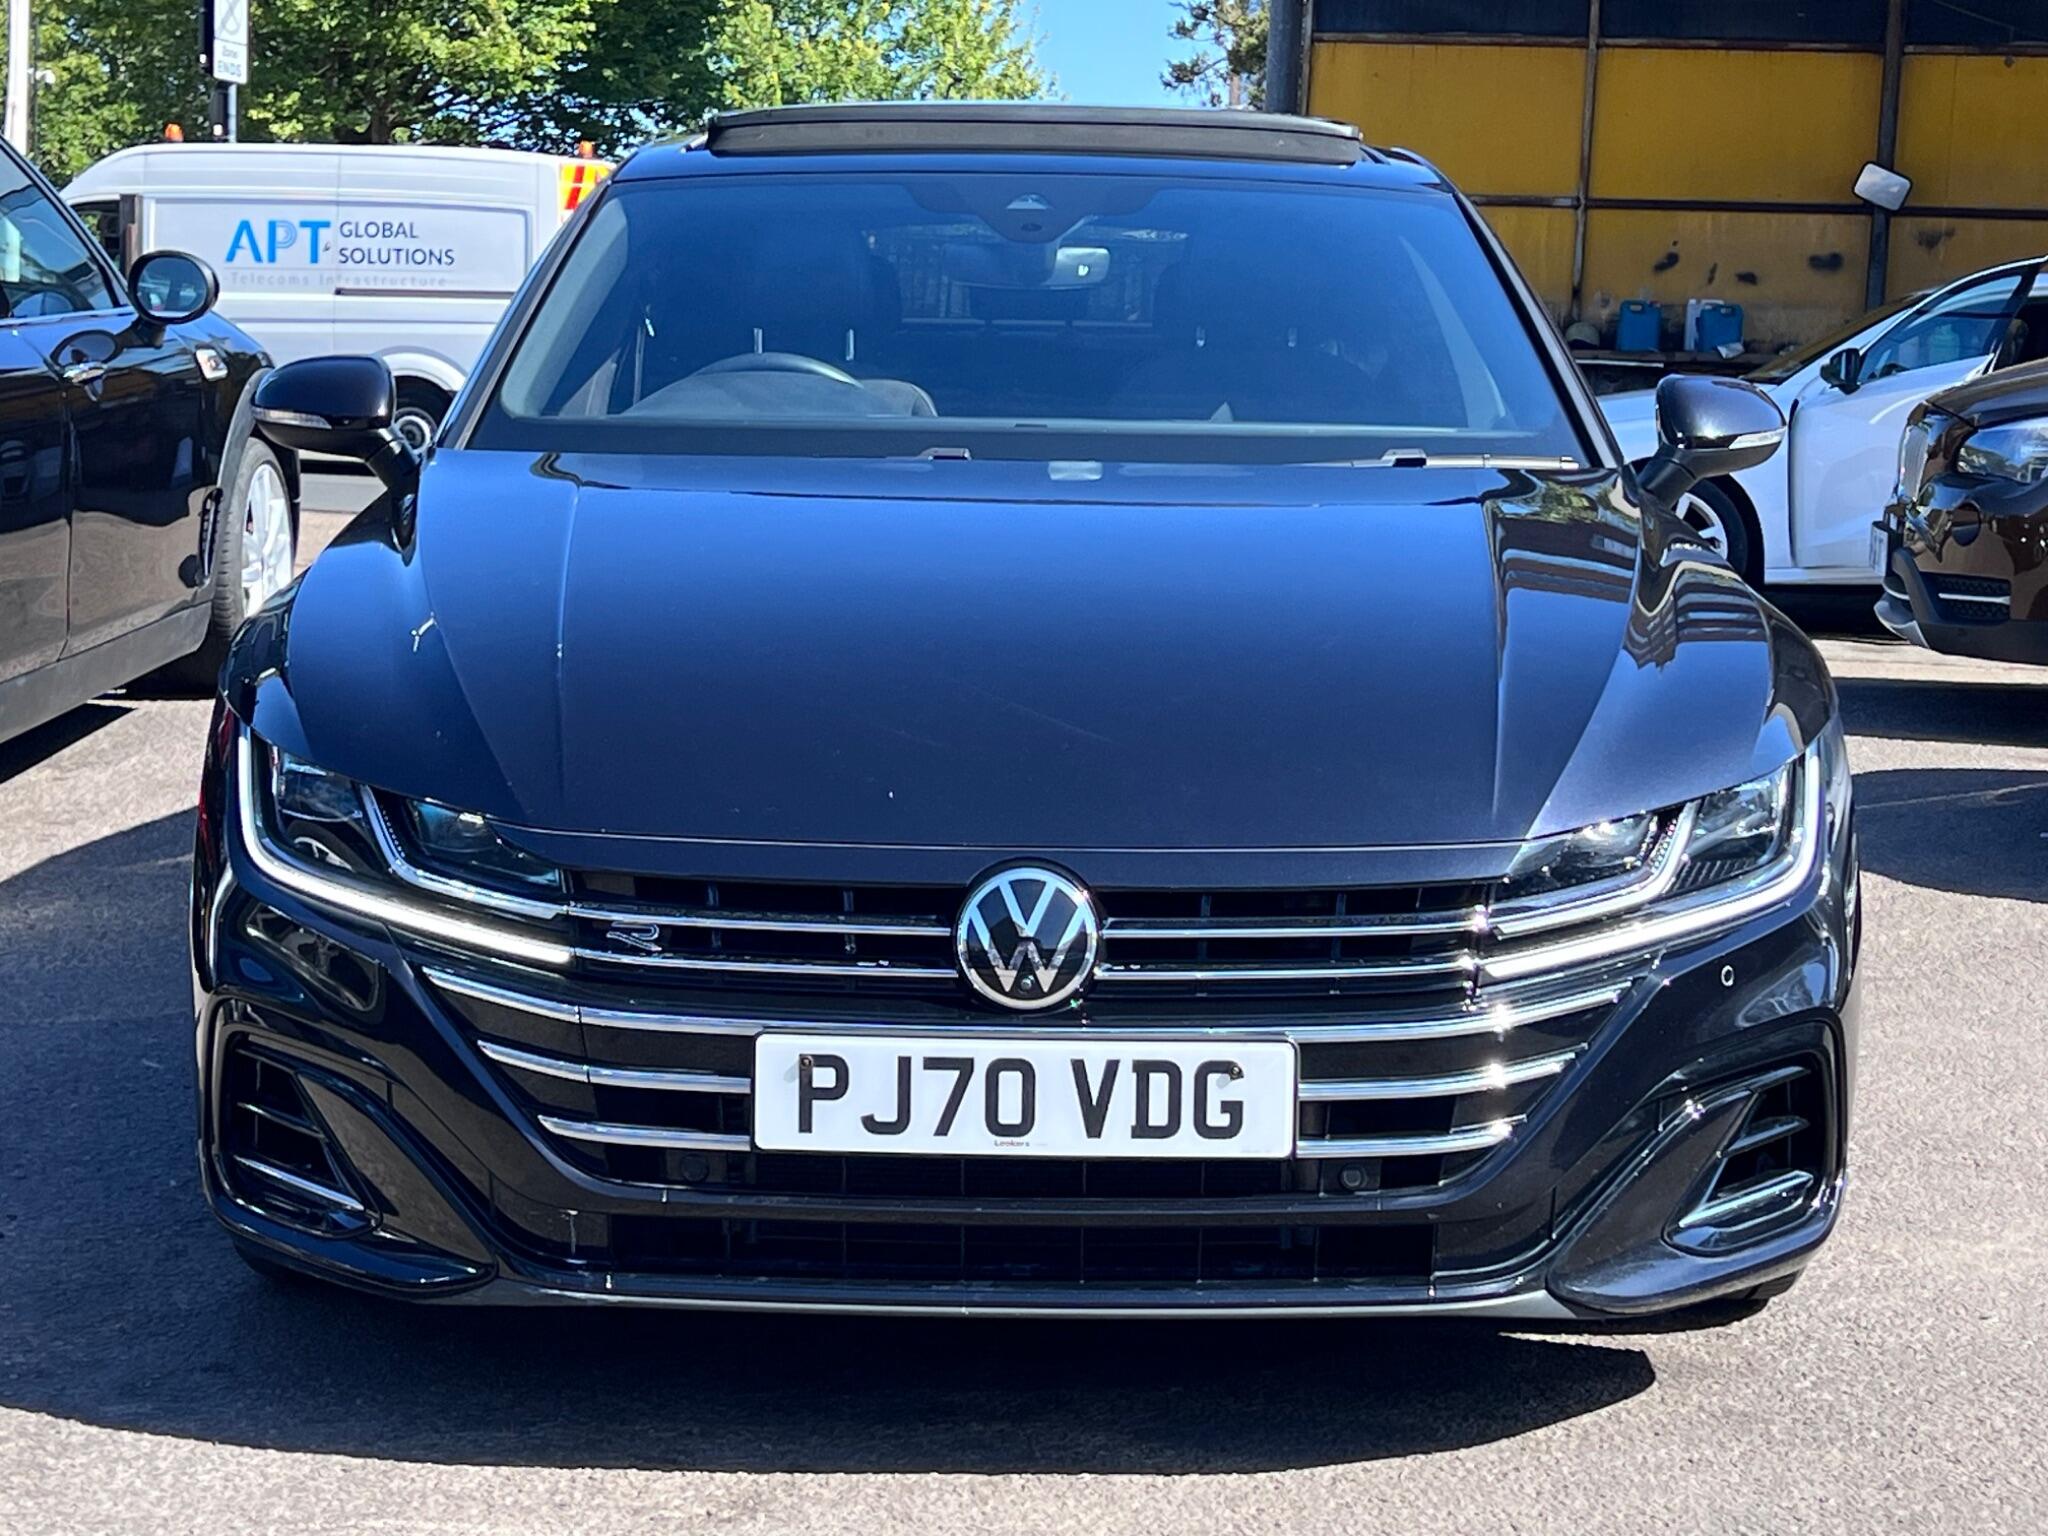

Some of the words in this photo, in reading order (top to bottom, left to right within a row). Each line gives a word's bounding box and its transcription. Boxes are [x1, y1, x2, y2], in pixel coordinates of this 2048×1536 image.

[339, 221, 419, 239] GLOBAL
[225, 219, 332, 265] APT
[338, 248, 456, 267] SOLUTIONS
[230, 272, 310, 286] Telecoms
[319, 273, 448, 288] Infrastructure
[798, 1053, 1037, 1138] PJ70
[1070, 1058, 1246, 1140] VDG
